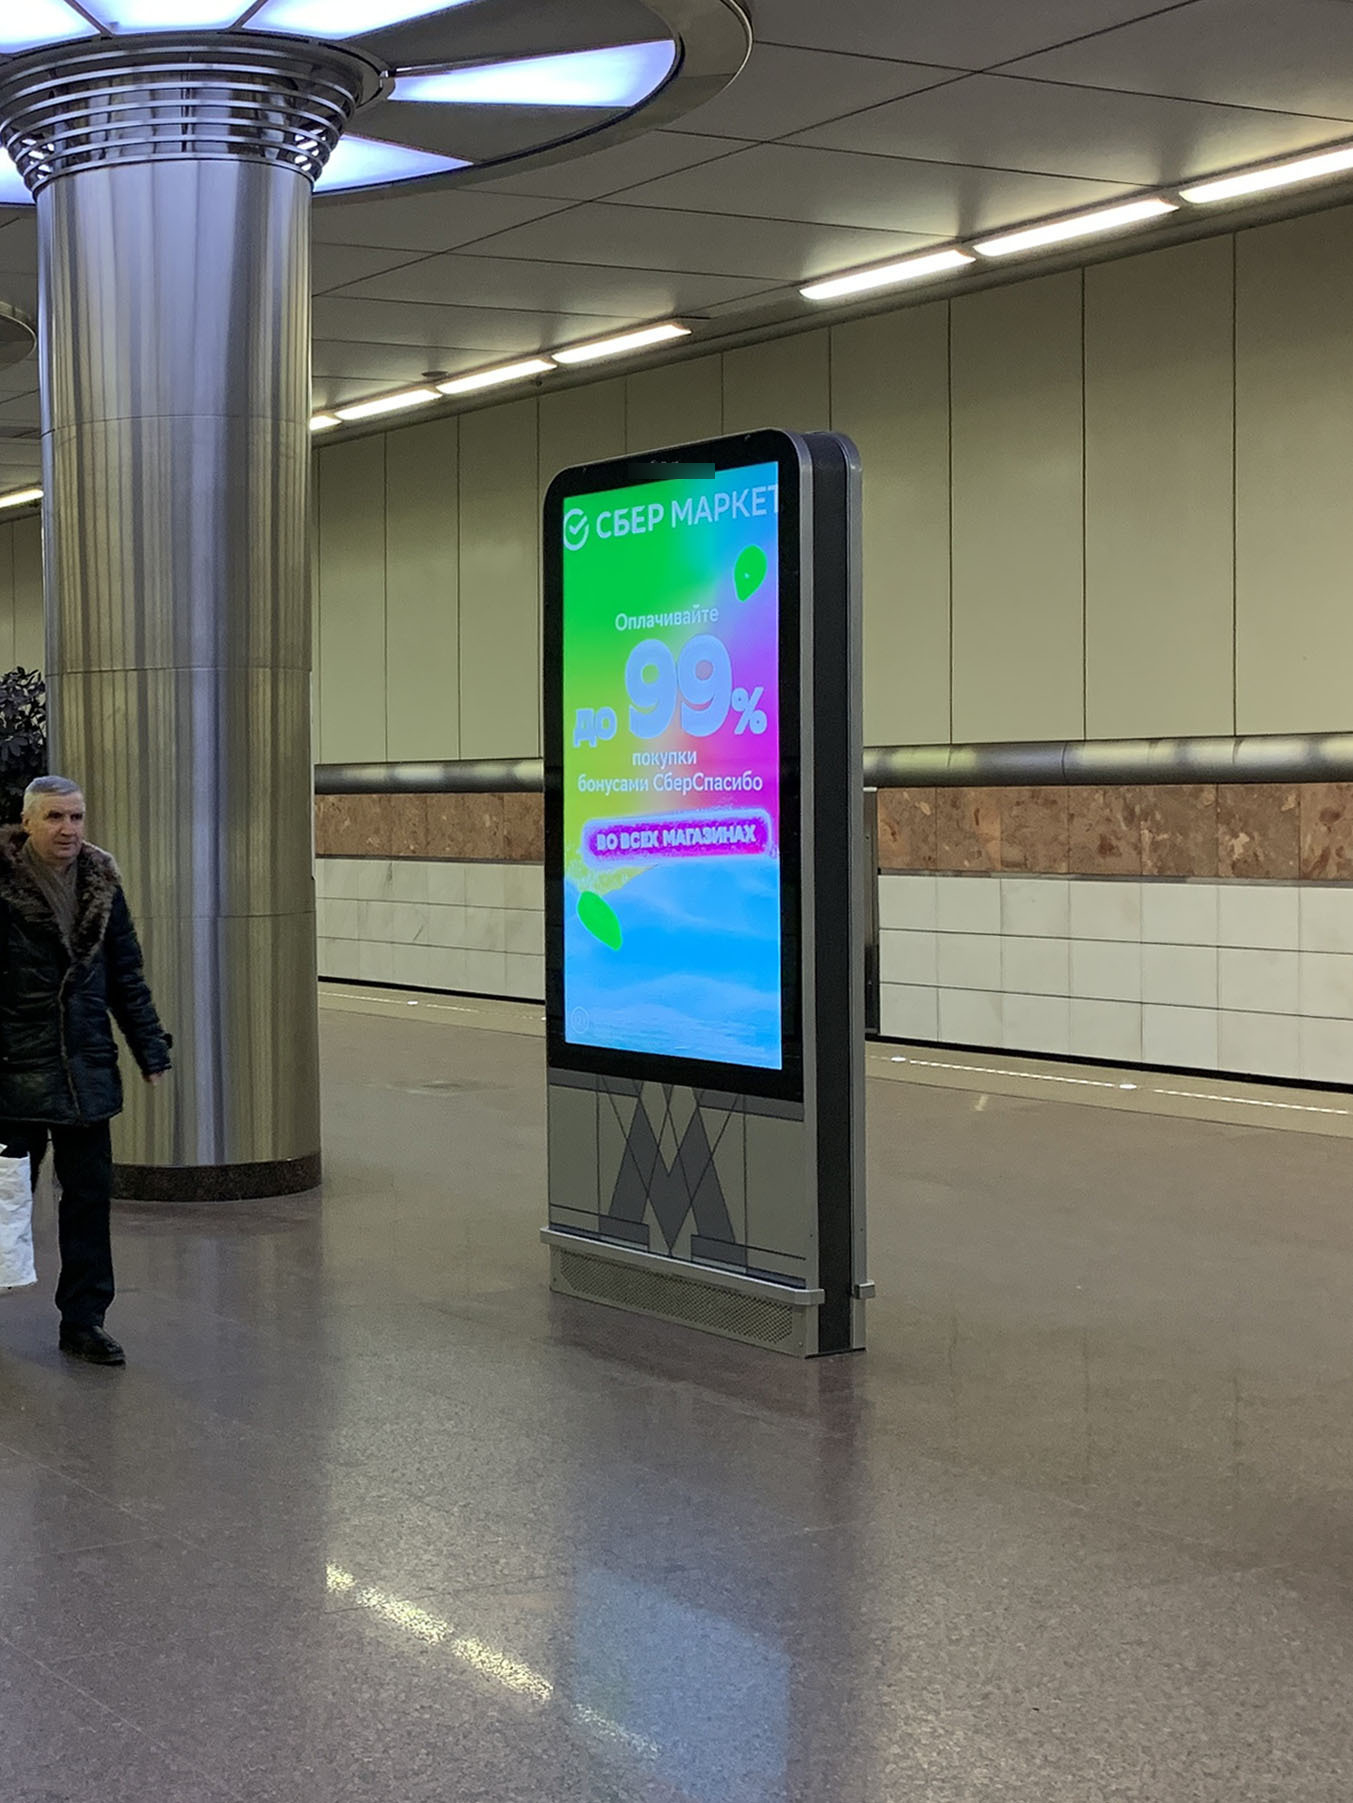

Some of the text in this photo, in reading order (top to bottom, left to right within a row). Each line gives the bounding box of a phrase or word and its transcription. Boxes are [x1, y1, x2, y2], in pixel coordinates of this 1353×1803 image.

[596, 484, 779, 539] СБЕР МАРКЕТ
[615, 604, 720, 631] Оплачивайте
[625, 634, 768, 740] 99%
[632, 751, 697, 770] покупки
[577, 770, 763, 796] бонусами СберСпасибо
[596, 824, 756, 850] ВО ВСЕХ МАГАЗИНАХ
